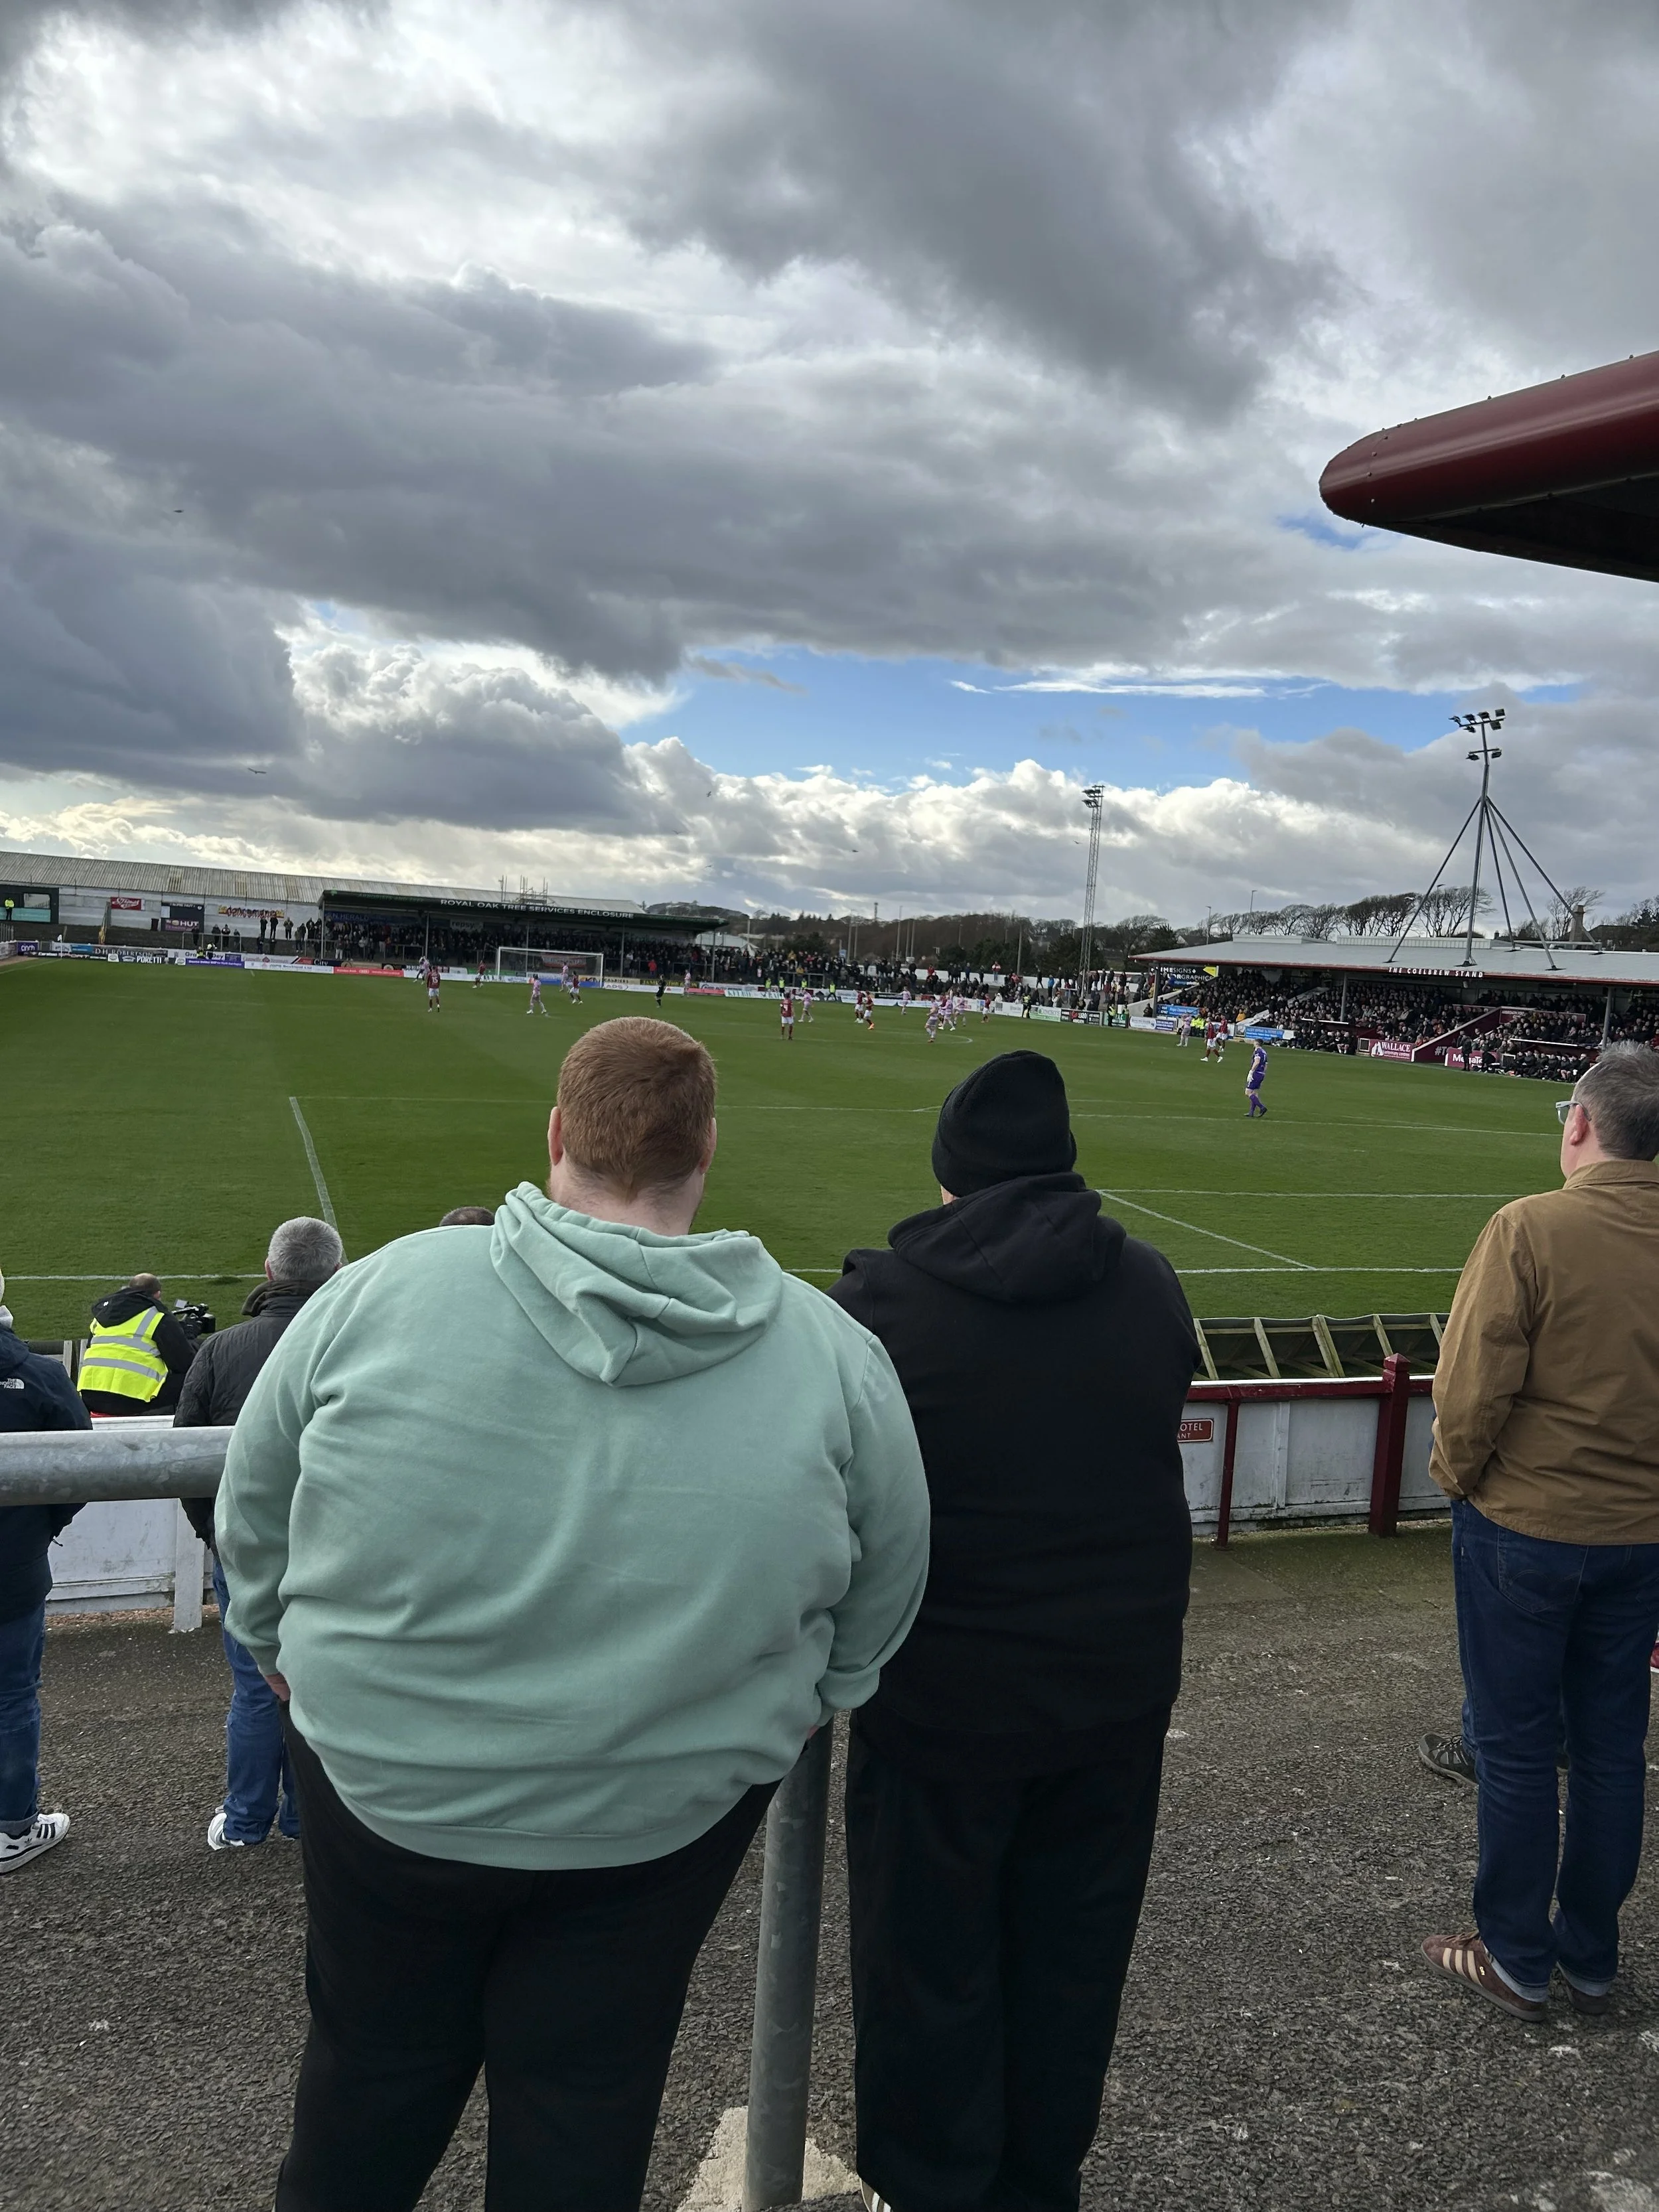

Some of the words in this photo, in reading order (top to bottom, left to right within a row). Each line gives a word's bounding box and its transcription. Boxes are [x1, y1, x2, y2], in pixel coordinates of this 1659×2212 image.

[529, 906, 575, 915] SERVICES
[578, 909, 634, 919] ENCLOSURE
[1382, 1041, 1411, 1052] WALLACE
